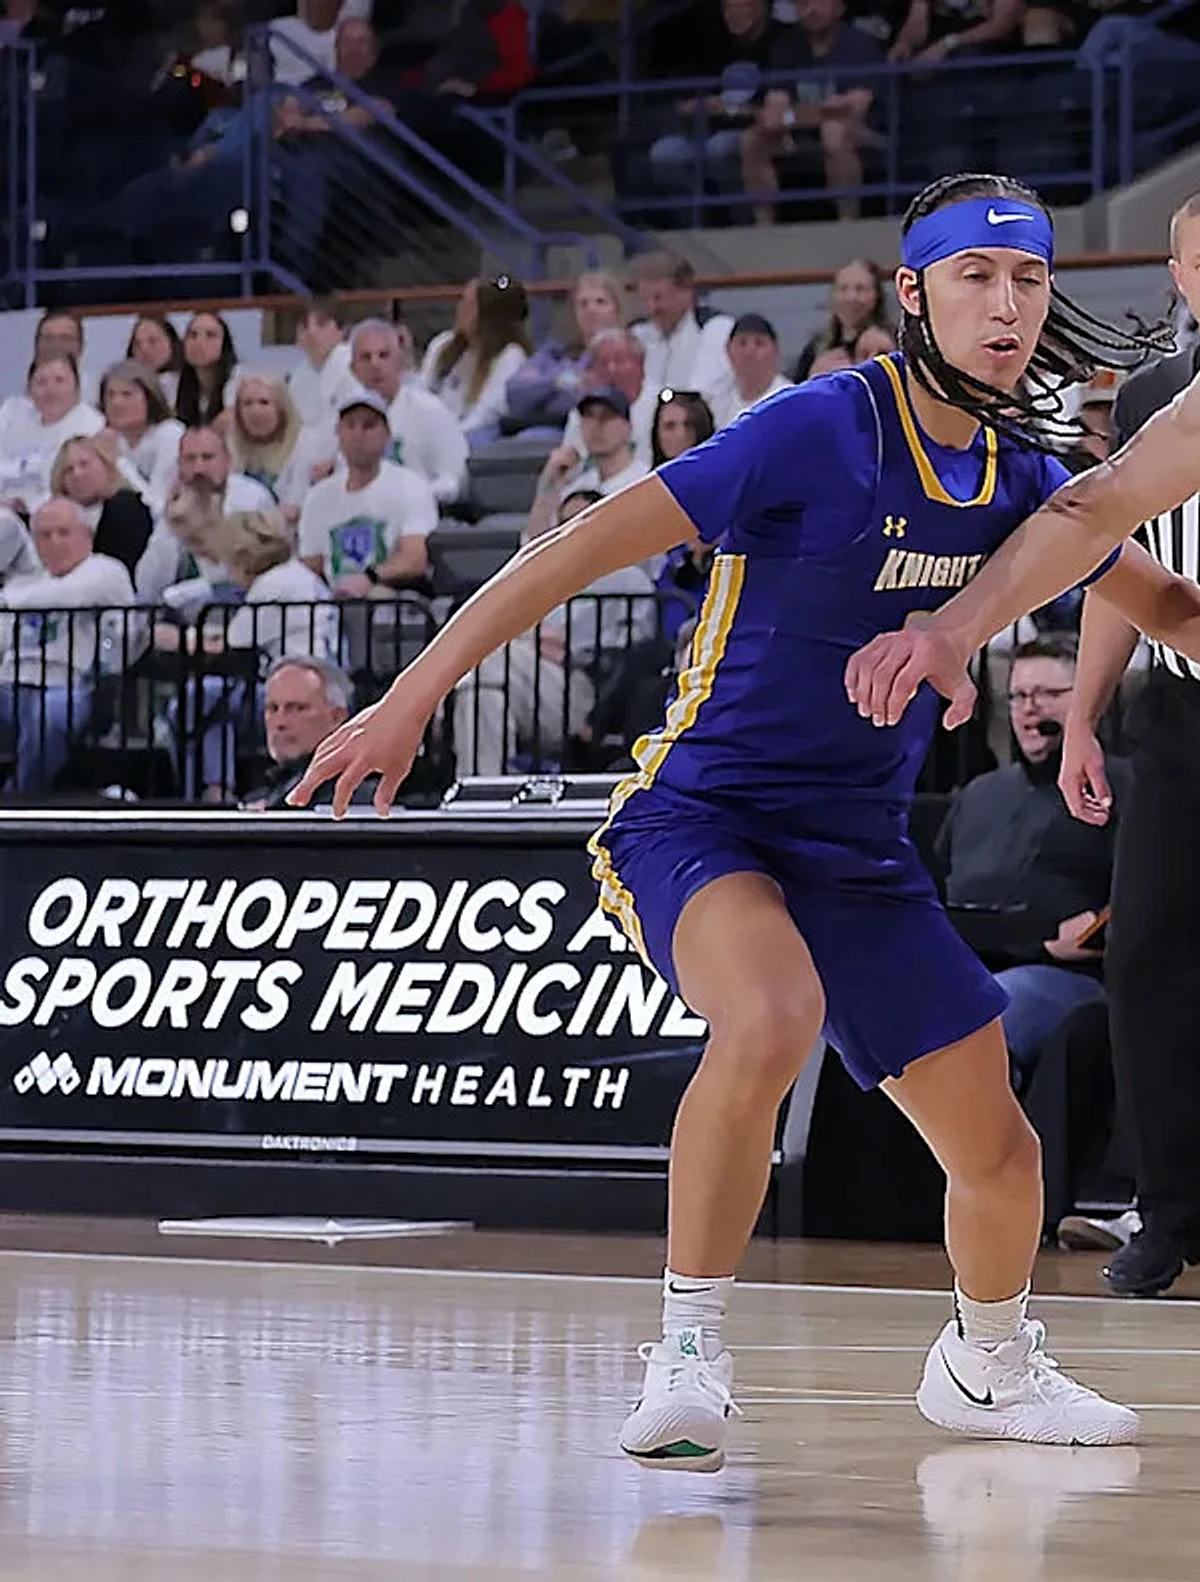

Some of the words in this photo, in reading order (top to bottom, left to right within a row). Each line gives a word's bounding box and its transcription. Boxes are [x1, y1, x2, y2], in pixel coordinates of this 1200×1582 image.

[873, 549, 984, 591] KNIGHT
[28, 877, 566, 952] ORTHOPEDICS
[0, 956, 303, 1030] SPORTS
[85, 1056, 408, 1103] MONUMENT
[411, 1063, 630, 1109] HEALTH
